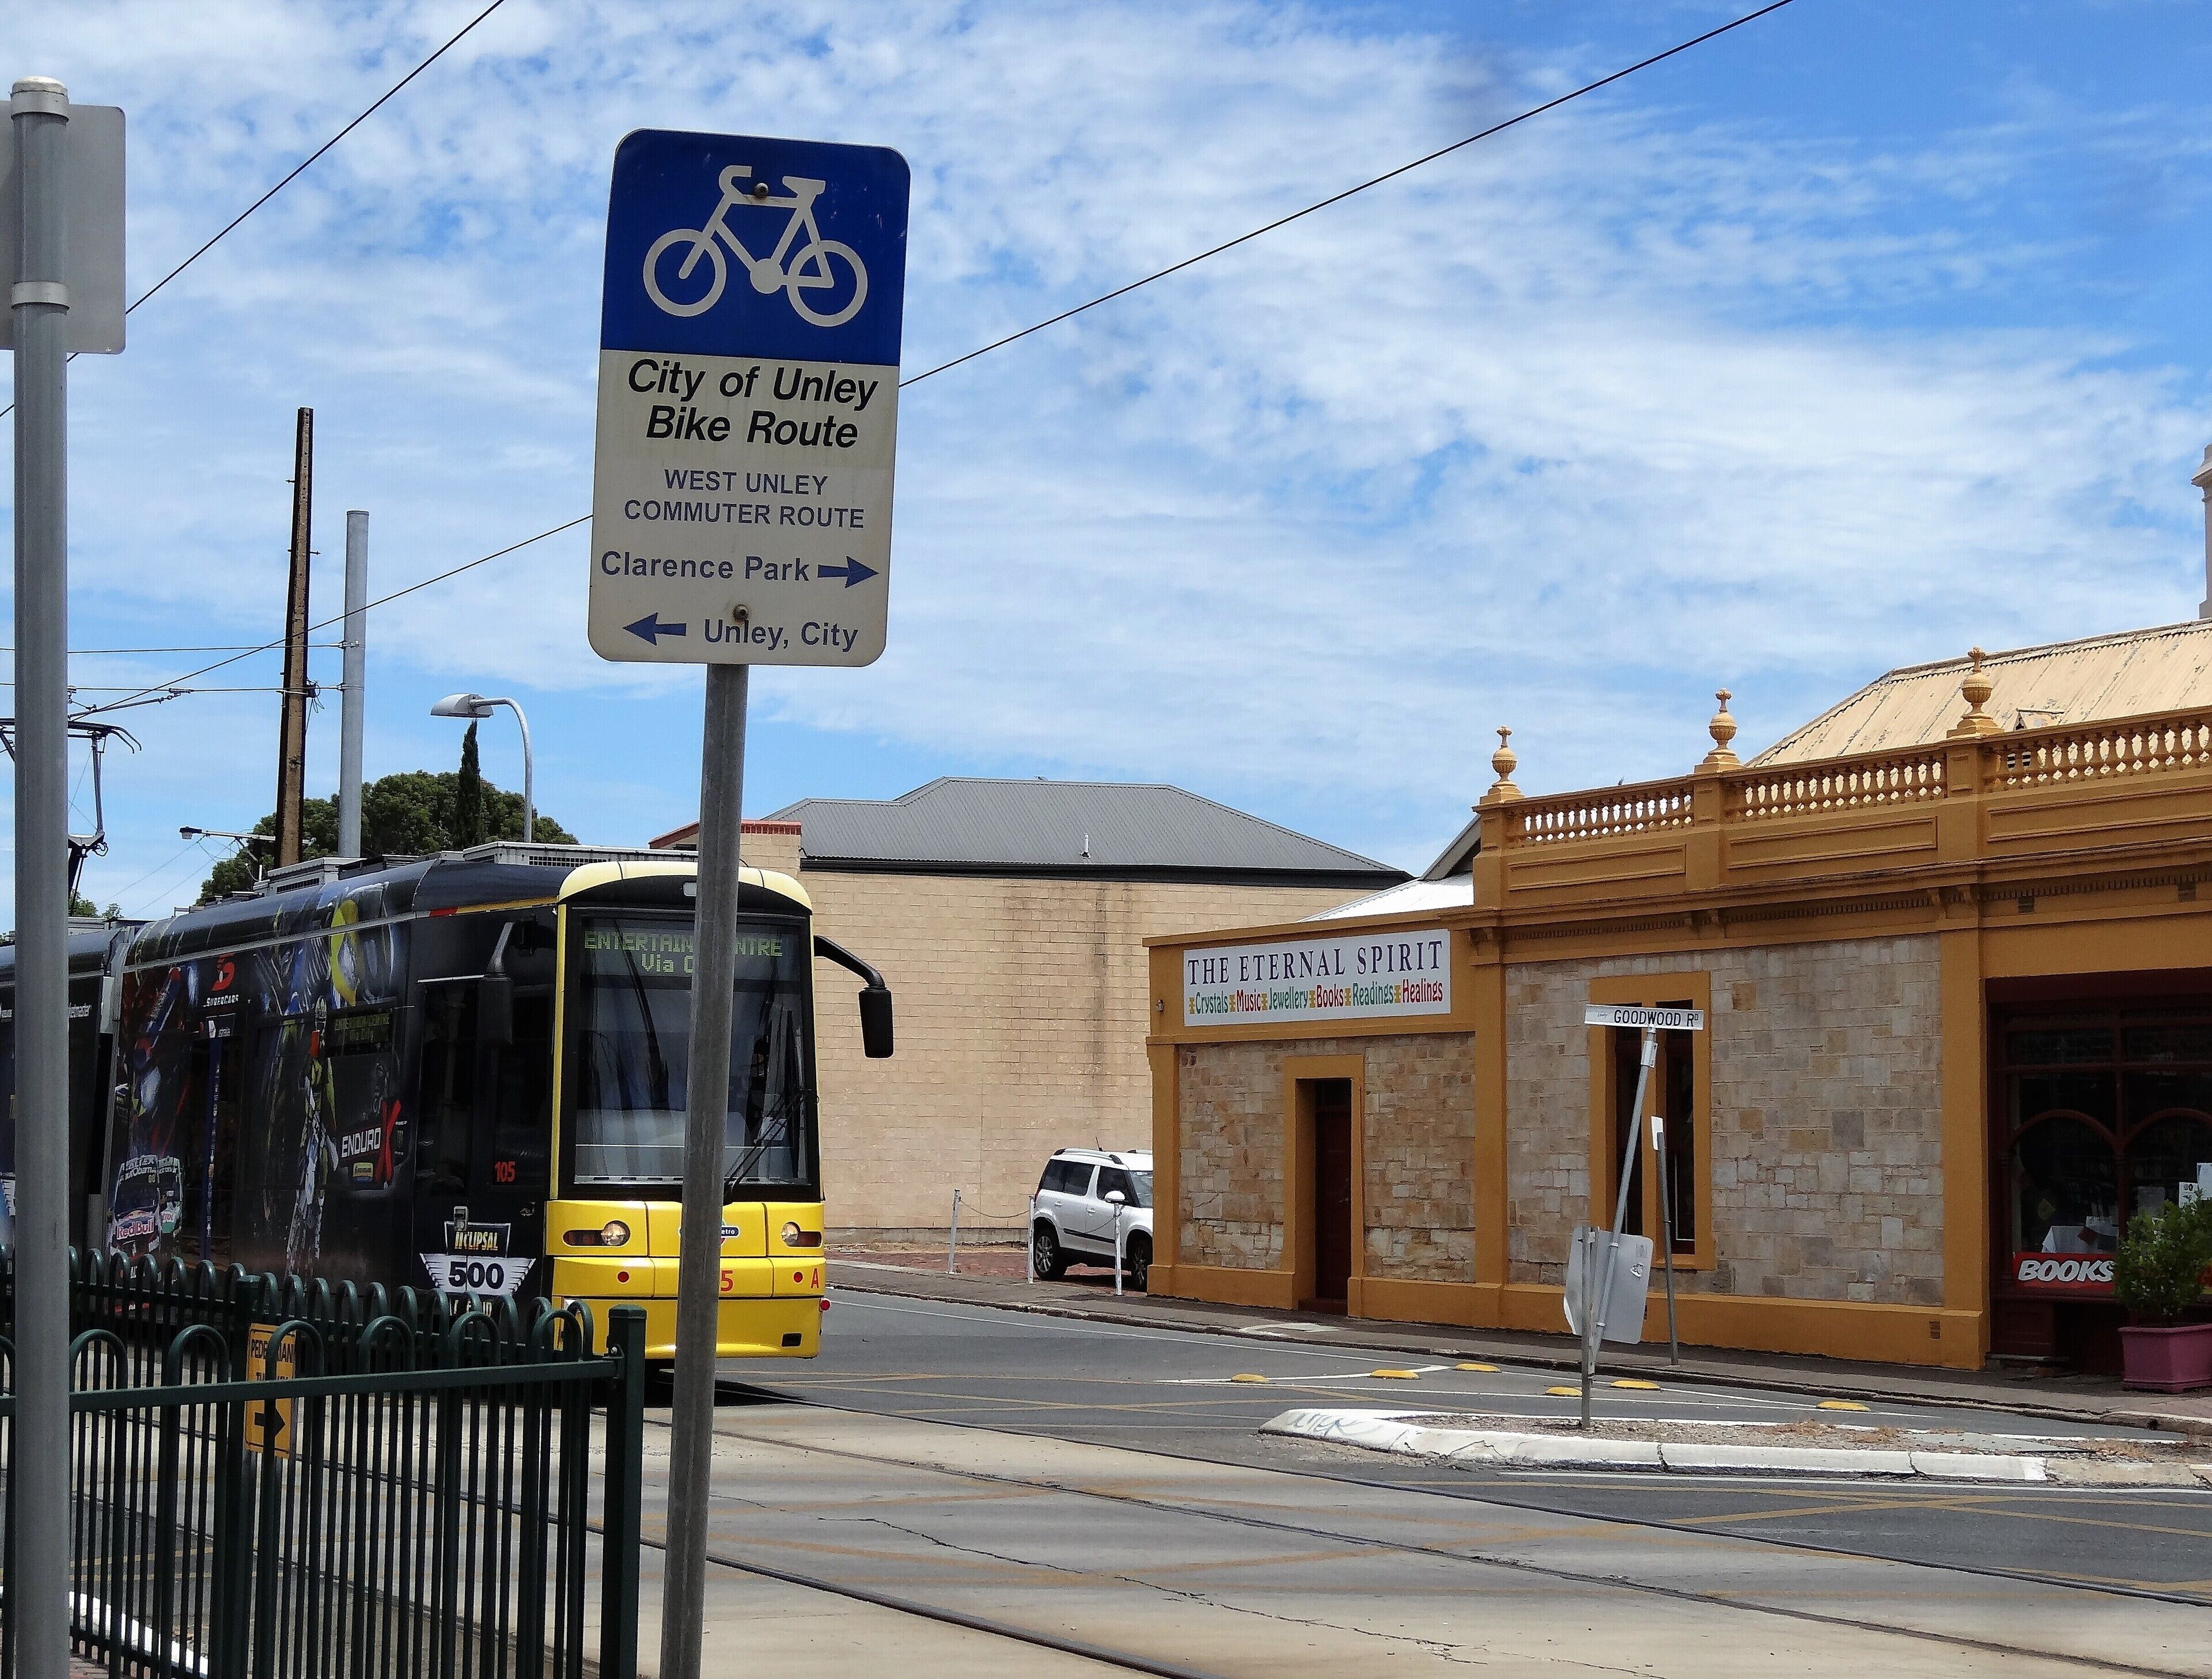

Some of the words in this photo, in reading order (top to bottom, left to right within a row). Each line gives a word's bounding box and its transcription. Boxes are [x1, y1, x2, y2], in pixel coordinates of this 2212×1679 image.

[628, 359, 706, 402] City
[719, 365, 760, 398] of
[774, 367, 878, 411] Unley
[646, 405, 730, 442] Bike
[747, 410, 858, 448] Route
[665, 469, 737, 491] WEST
[745, 472, 828, 495] UNLEY
[624, 500, 770, 525] COMMUTER
[779, 505, 864, 528] ROUTE
[601, 551, 733, 579] Clarence
[745, 556, 810, 581] Park
[704, 619, 788, 650] Unley,
[801, 622, 858, 652] City
[584, 931, 694, 952] ENTERTAIN
[734, 936, 783, 956] NTRE
[641, 953, 674, 973] Via
[1188, 956, 1229, 985] THE
[1239, 948, 1346, 982] ETERNAL
[1357, 940, 1443, 974] SPIRIT
[1195, 989, 1229, 1014] Crystals
[1236, 988, 1261, 1012] Music
[1268, 986, 1309, 1012] Jewellery
[1316, 983, 1344, 1008] Books
[1353, 981, 1394, 1007] Readings
[1403, 978, 1443, 1004] Healings
[1614, 1009, 1681, 1026] GOODWOOD
[341, 1127, 381, 1158] ENDURO
[494, 1161, 516, 1182] 105
[116, 1222, 134, 1239] Red
[135, 1217, 154, 1234] Bull
[454, 1231, 498, 1251] CLIPSAL
[448, 1261, 505, 1289] 500
[721, 1270, 734, 1292] 5
[810, 1268, 820, 1289] A
[2018, 1260, 2115, 1282] BOOKS
[252, 1338, 294, 1363] PEDEIAN
